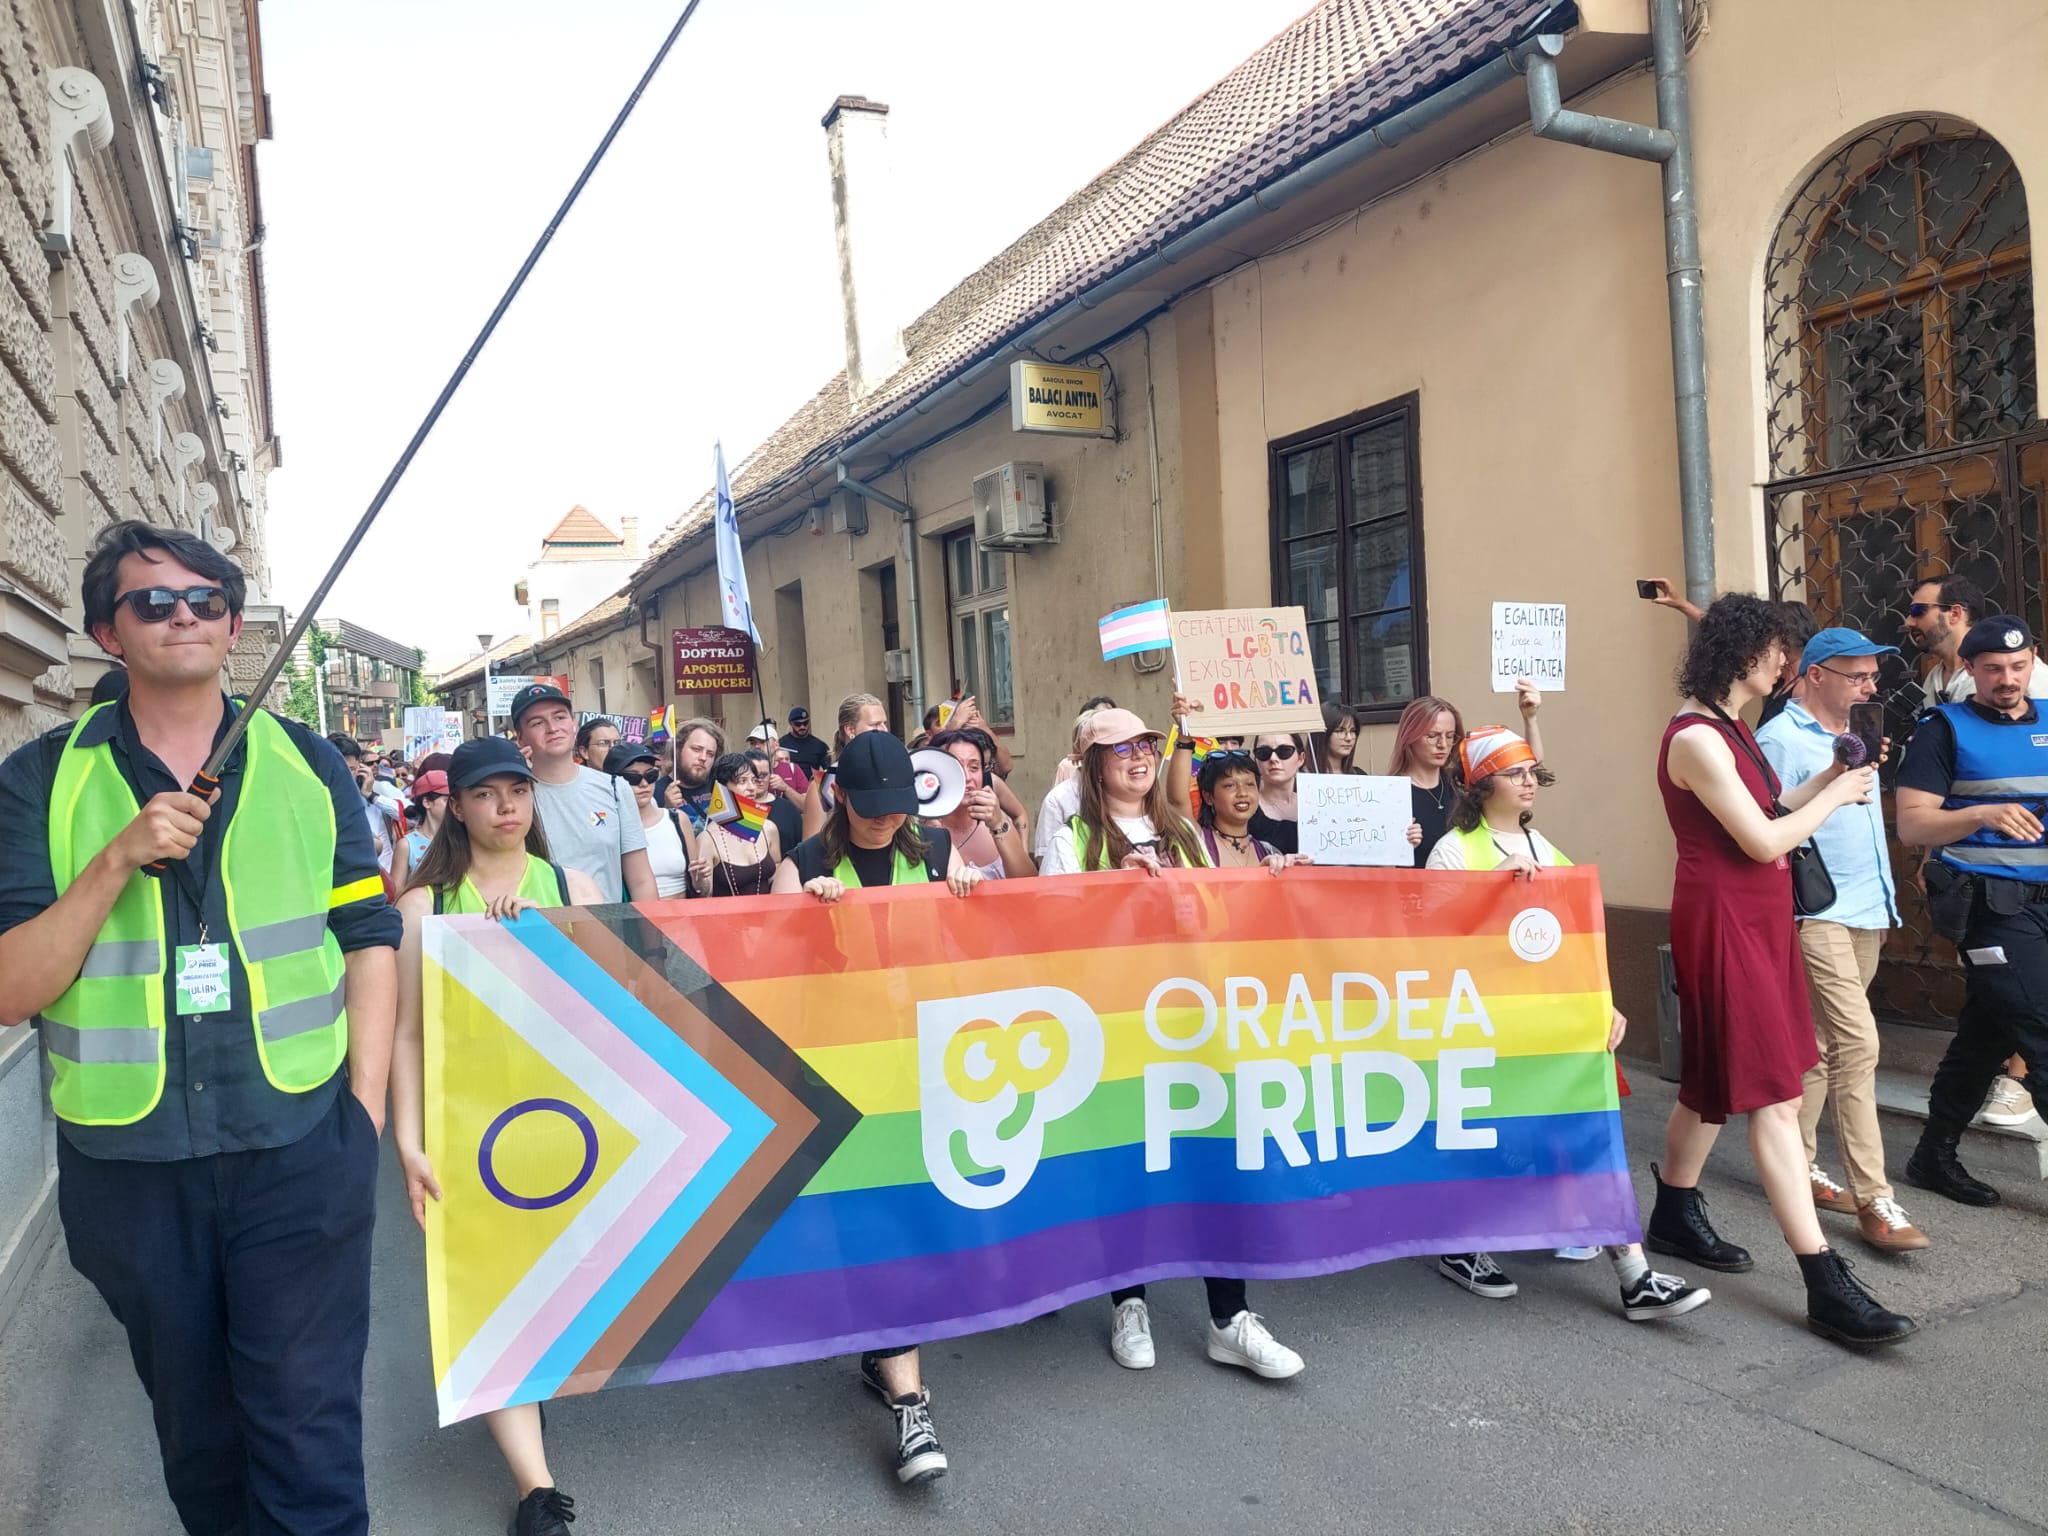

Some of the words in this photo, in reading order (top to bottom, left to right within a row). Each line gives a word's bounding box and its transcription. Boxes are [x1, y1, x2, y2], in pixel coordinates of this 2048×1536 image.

[1029, 387, 1062, 406] BALACI
[1046, 410, 1083, 420] AVOCAT
[1504, 606, 1565, 627] EGALITATEA
[680, 648, 745, 659] DOFTRAD
[1226, 631, 1304, 659] LGBTQ
[682, 663, 745, 675] APOSTILE
[1498, 656, 1564, 678] LEGALITATEA
[676, 677, 752, 690] TRADUCERI
[1214, 679, 1313, 710] ORADEA
[623, 715, 647, 737] EGALE
[1317, 786, 1380, 807] DREPTUL
[1319, 825, 1387, 852] DREPTURI
[1523, 927, 1548, 942] Ark
[1144, 968, 1495, 1052] ORADEA
[1143, 1047, 1498, 1173] PRIDE
